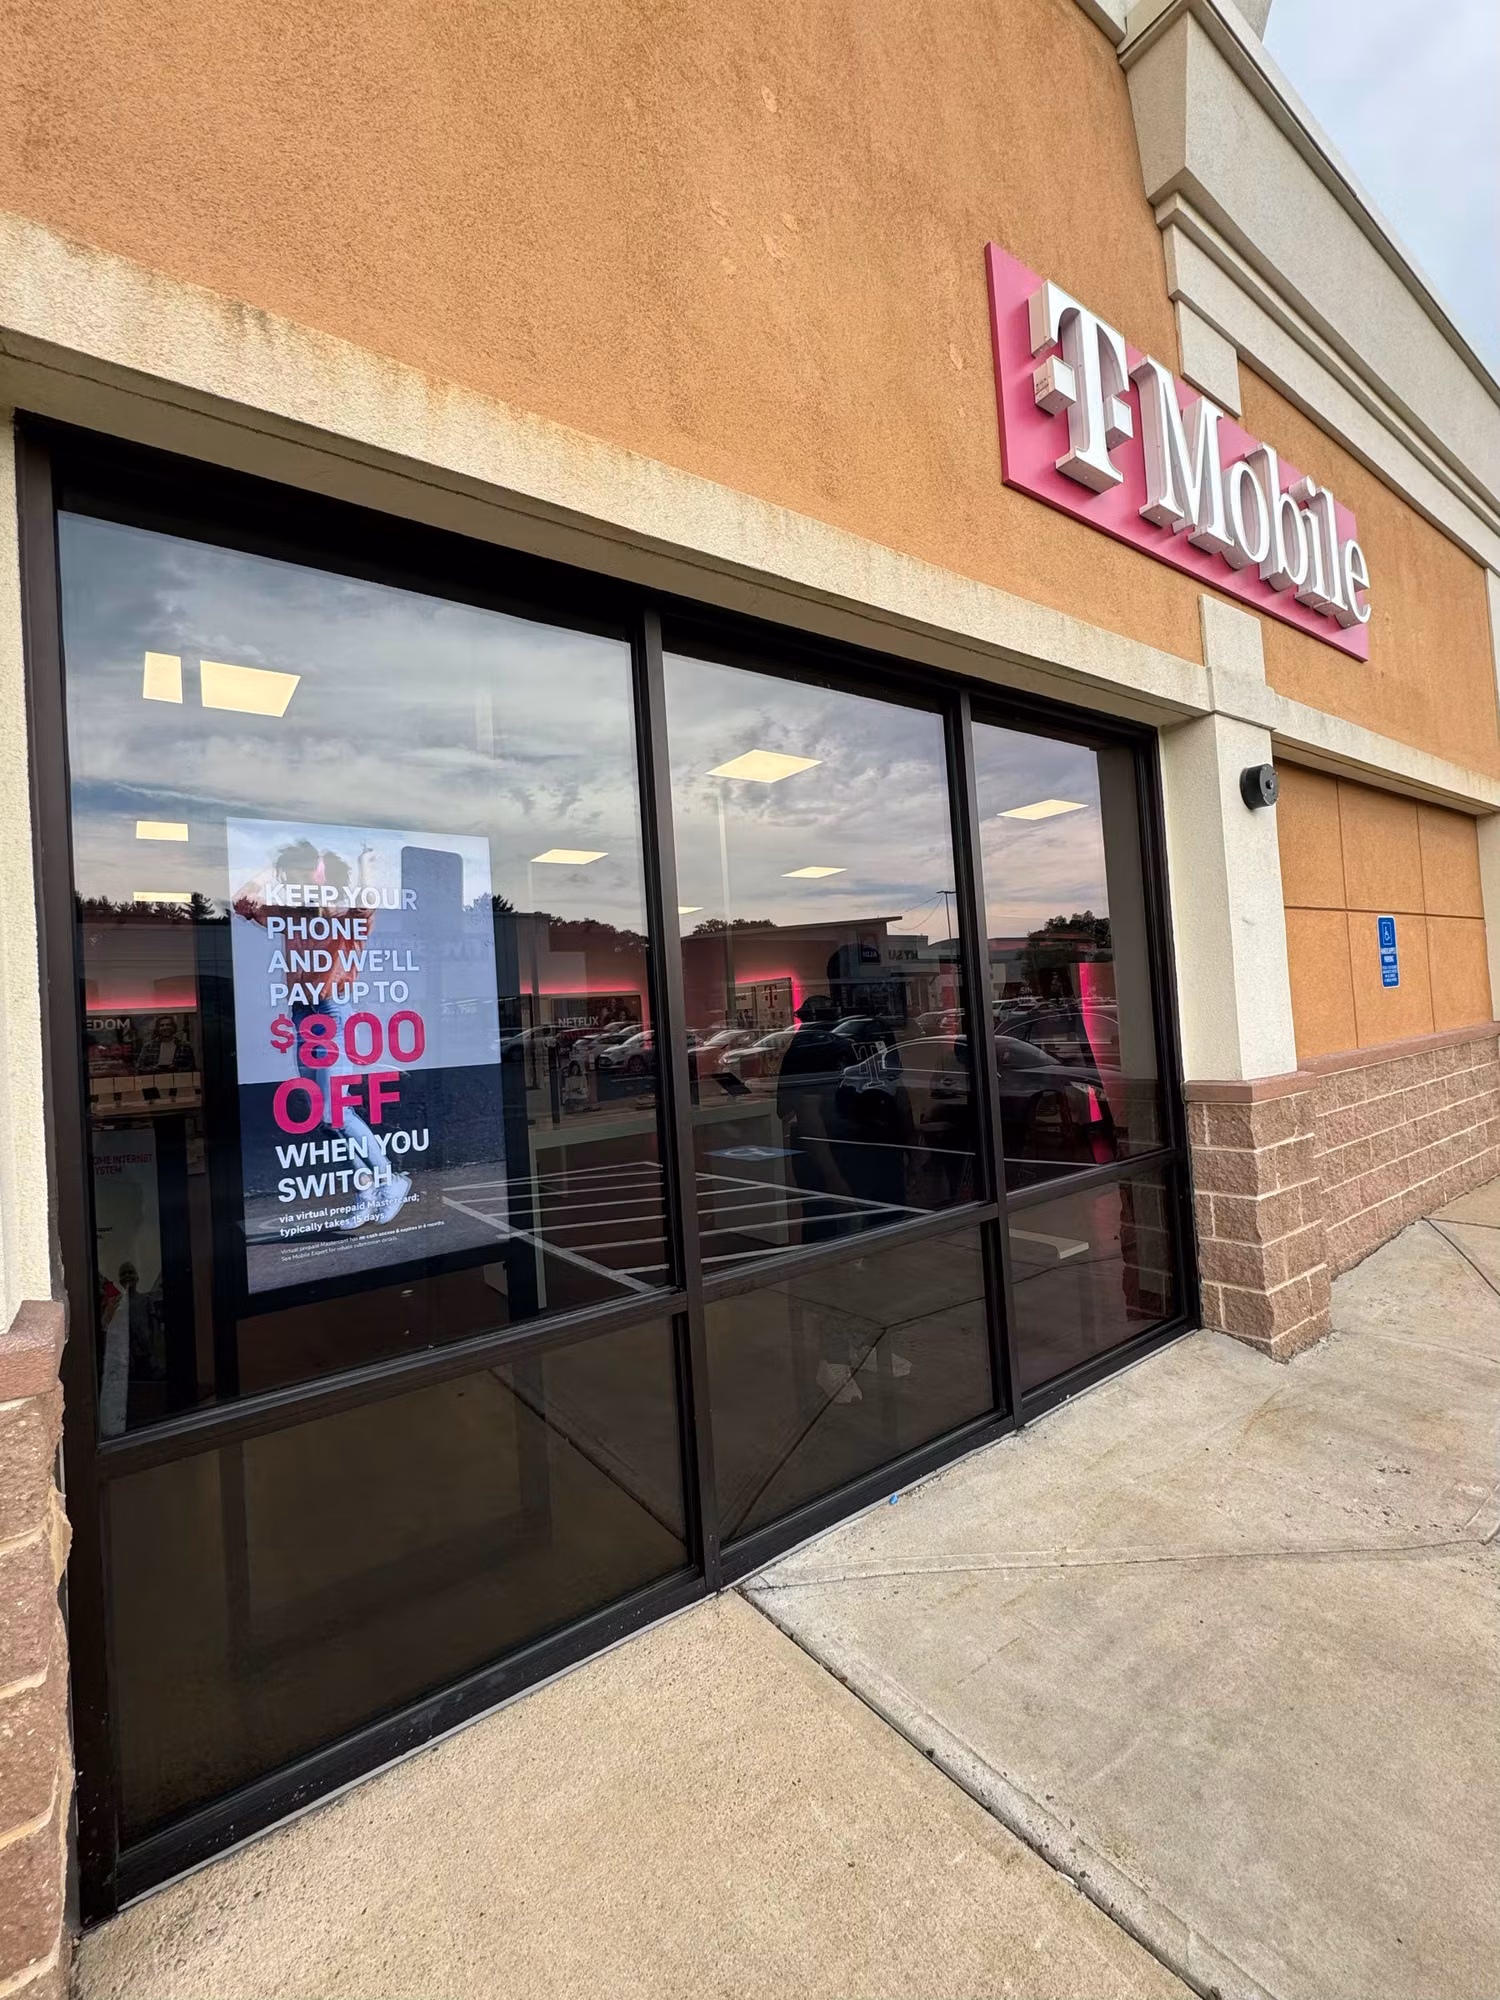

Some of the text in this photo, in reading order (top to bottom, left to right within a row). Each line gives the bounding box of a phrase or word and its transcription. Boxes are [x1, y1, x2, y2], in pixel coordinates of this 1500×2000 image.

[265, 884, 417, 910] KEEP YOUR
[266, 916, 368, 940] PHONE
[268, 950, 420, 973] AND WE'LL
[270, 980, 409, 1006] PAY UP TO
[558, 1016, 599, 1028] NETFLIX
[270, 1010, 425, 1070] $800
[273, 1071, 401, 1134] OFF
[275, 1128, 430, 1169] WHEN YOU
[278, 1164, 392, 1202] SWITCH
[279, 1214, 294, 1223] via
[296, 1208, 328, 1220] virtual
[330, 1202, 365, 1216] prepaid
[280, 1222, 323, 1238] typically
[324, 1218, 350, 1229] takes
[352, 1214, 362, 1224] 15
